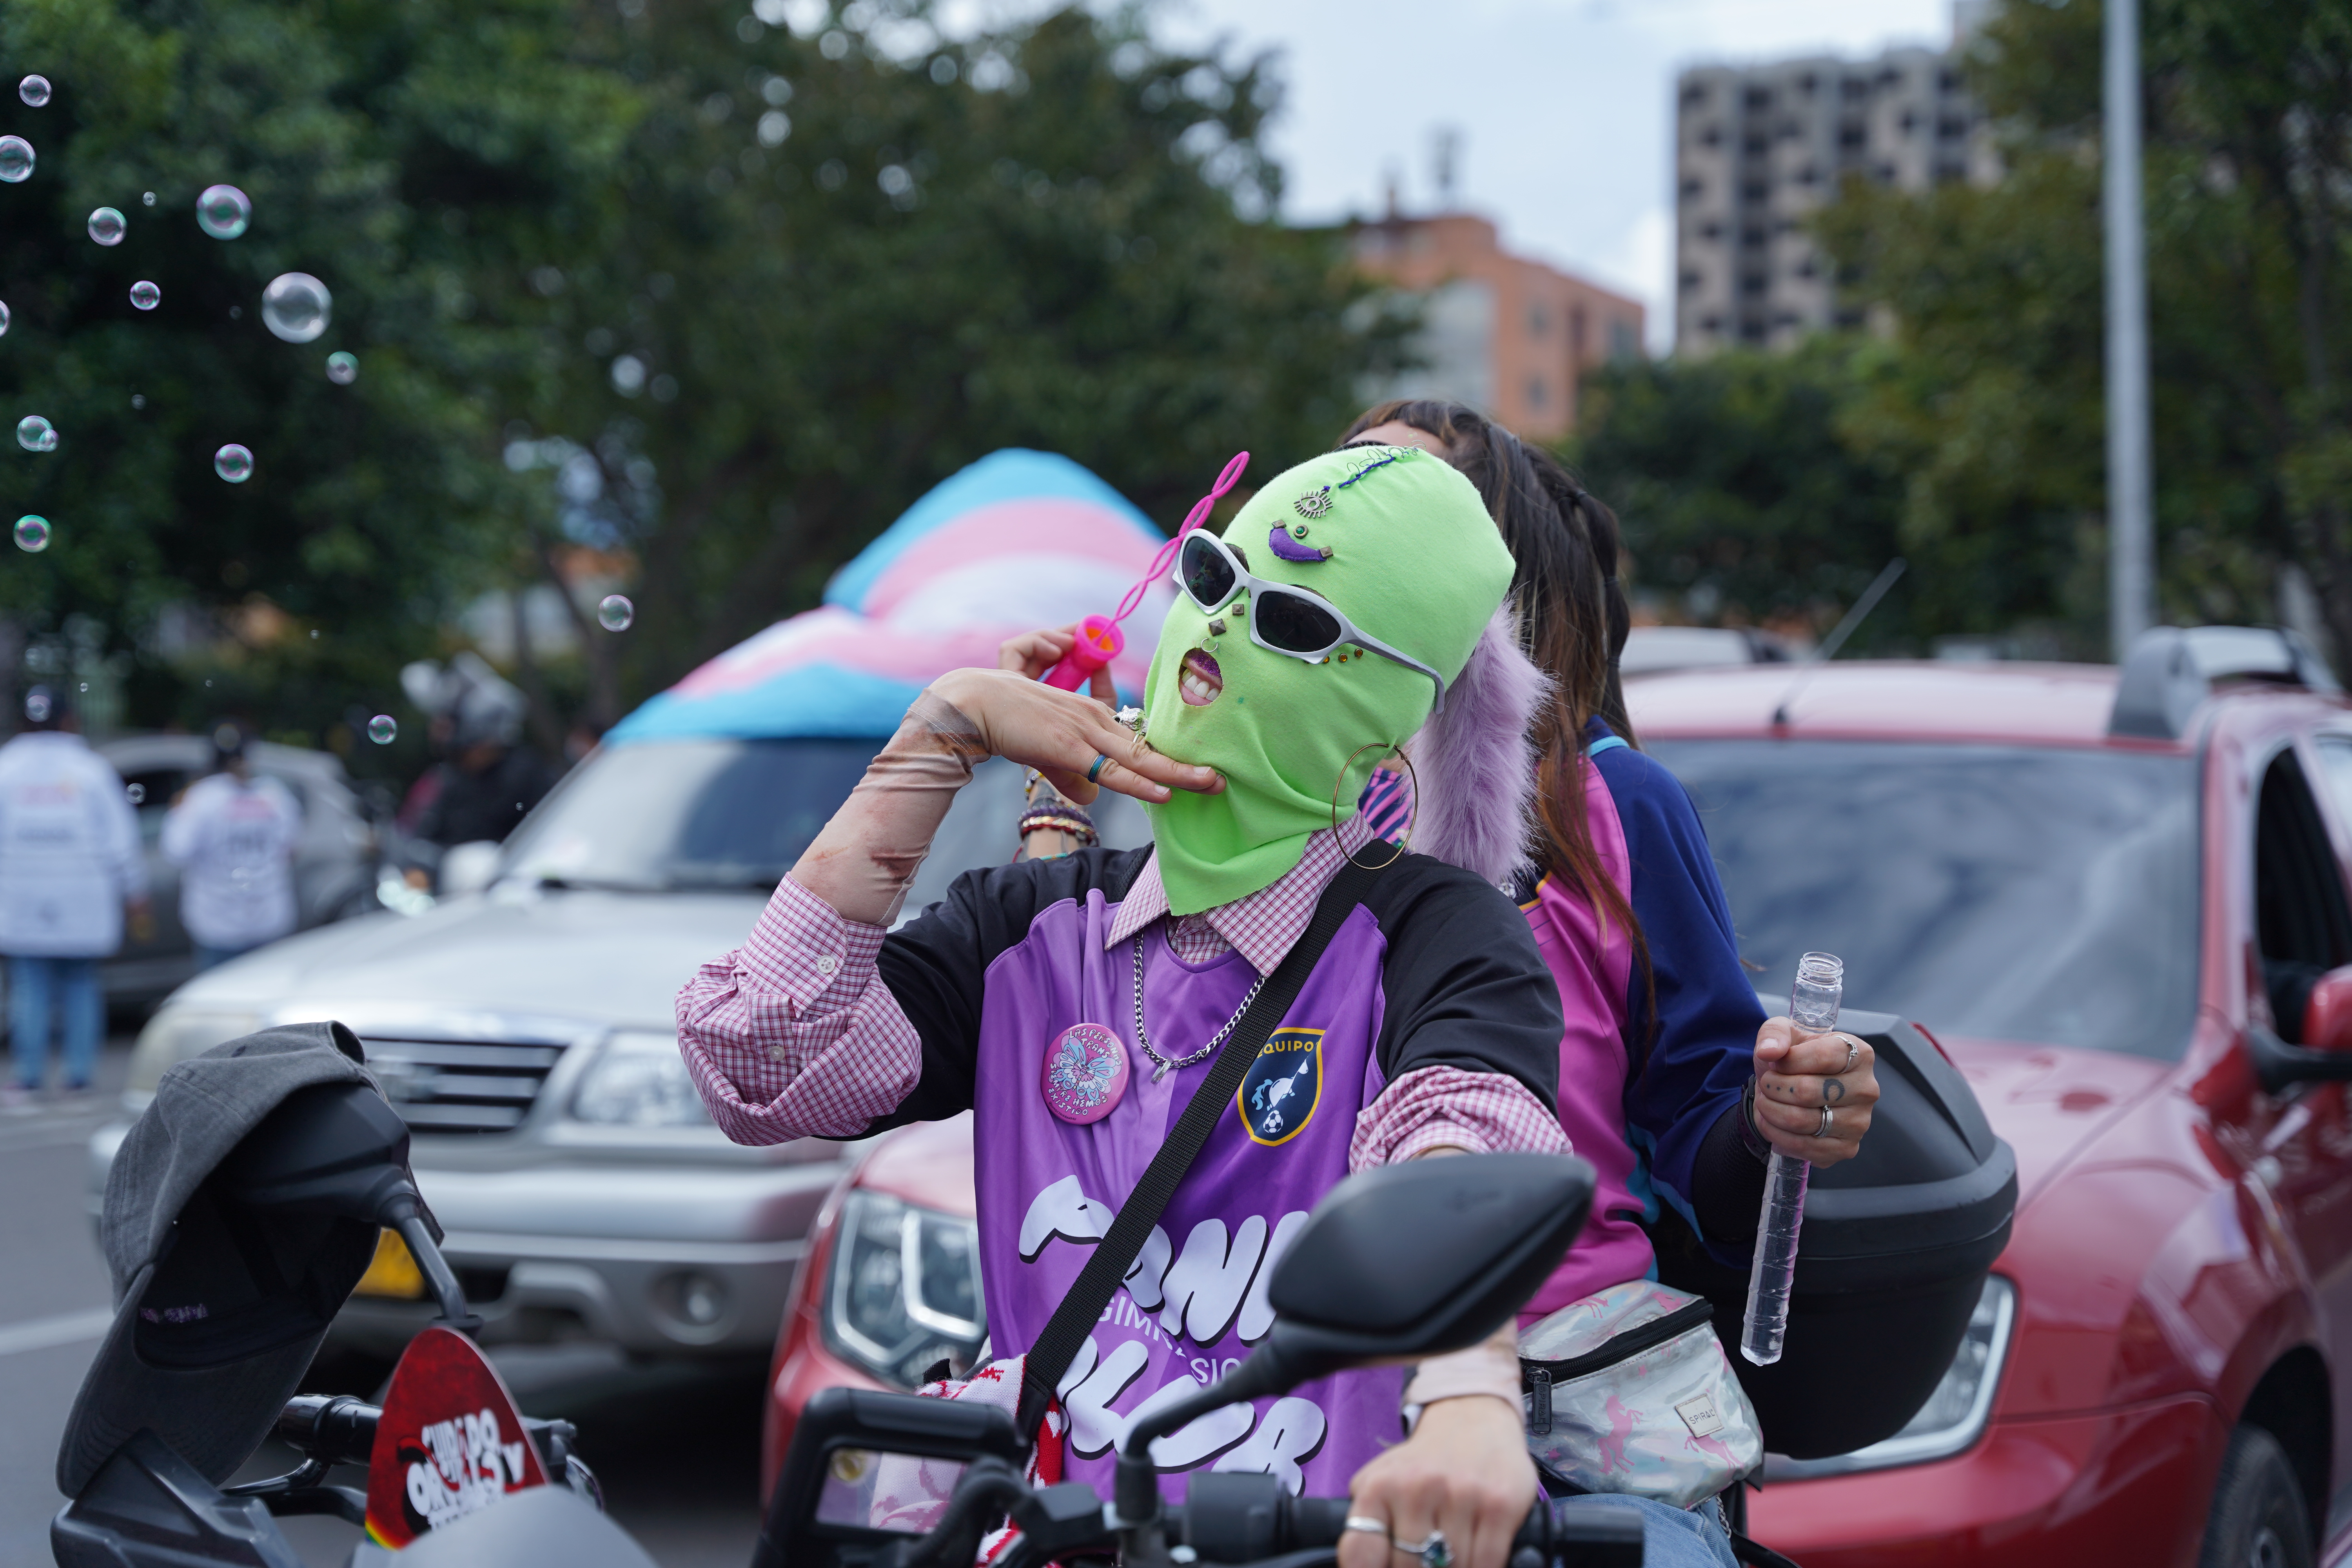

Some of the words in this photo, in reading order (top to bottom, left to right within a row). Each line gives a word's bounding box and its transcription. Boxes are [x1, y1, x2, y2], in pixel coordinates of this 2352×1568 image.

[1069, 1028, 1087, 1039] LAS
[1089, 1029, 1123, 1066] PERSONAS
[1080, 1038, 1110, 1058] TRANS
[1050, 1063, 1071, 1102] SIEMPRE
[1073, 1095, 1108, 1108] HEMOS
[1048, 1088, 1088, 1116] EXISTIDO
[1689, 1408, 1715, 1424] SPIRAL
